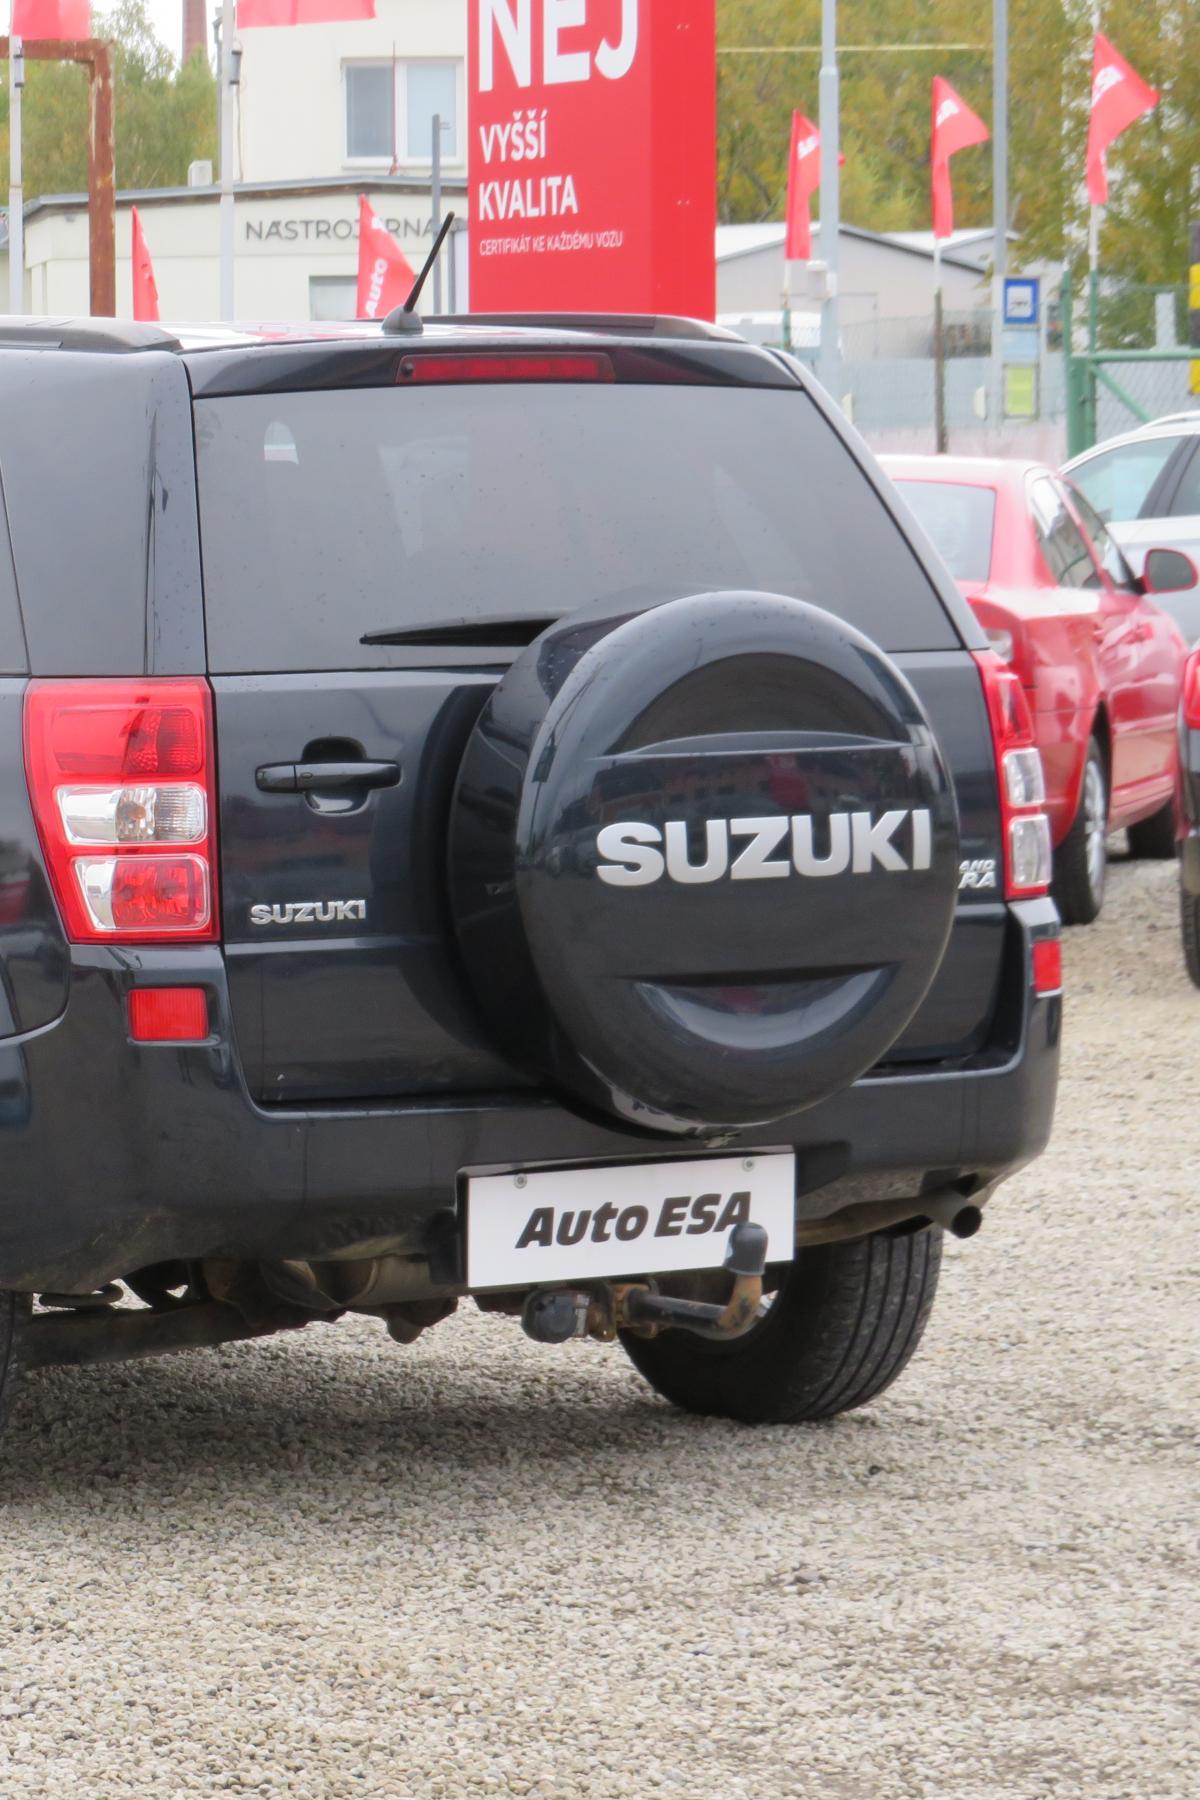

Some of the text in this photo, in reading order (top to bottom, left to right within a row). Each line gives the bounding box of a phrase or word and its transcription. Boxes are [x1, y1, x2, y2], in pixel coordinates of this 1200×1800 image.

[479, 0, 639, 92] NEJ
[479, 109, 548, 164] VYŠŠÍ
[479, 175, 578, 221] KVALITA
[479, 230, 624, 256] CERTIFIKÁT KE KAŽDÉMU VOZU
[597, 809, 932, 887] SUZUKI
[959, 858, 997, 873] AND
[250, 899, 367, 925] SUZUKI
[514, 1191, 752, 1249] Auto ESA
